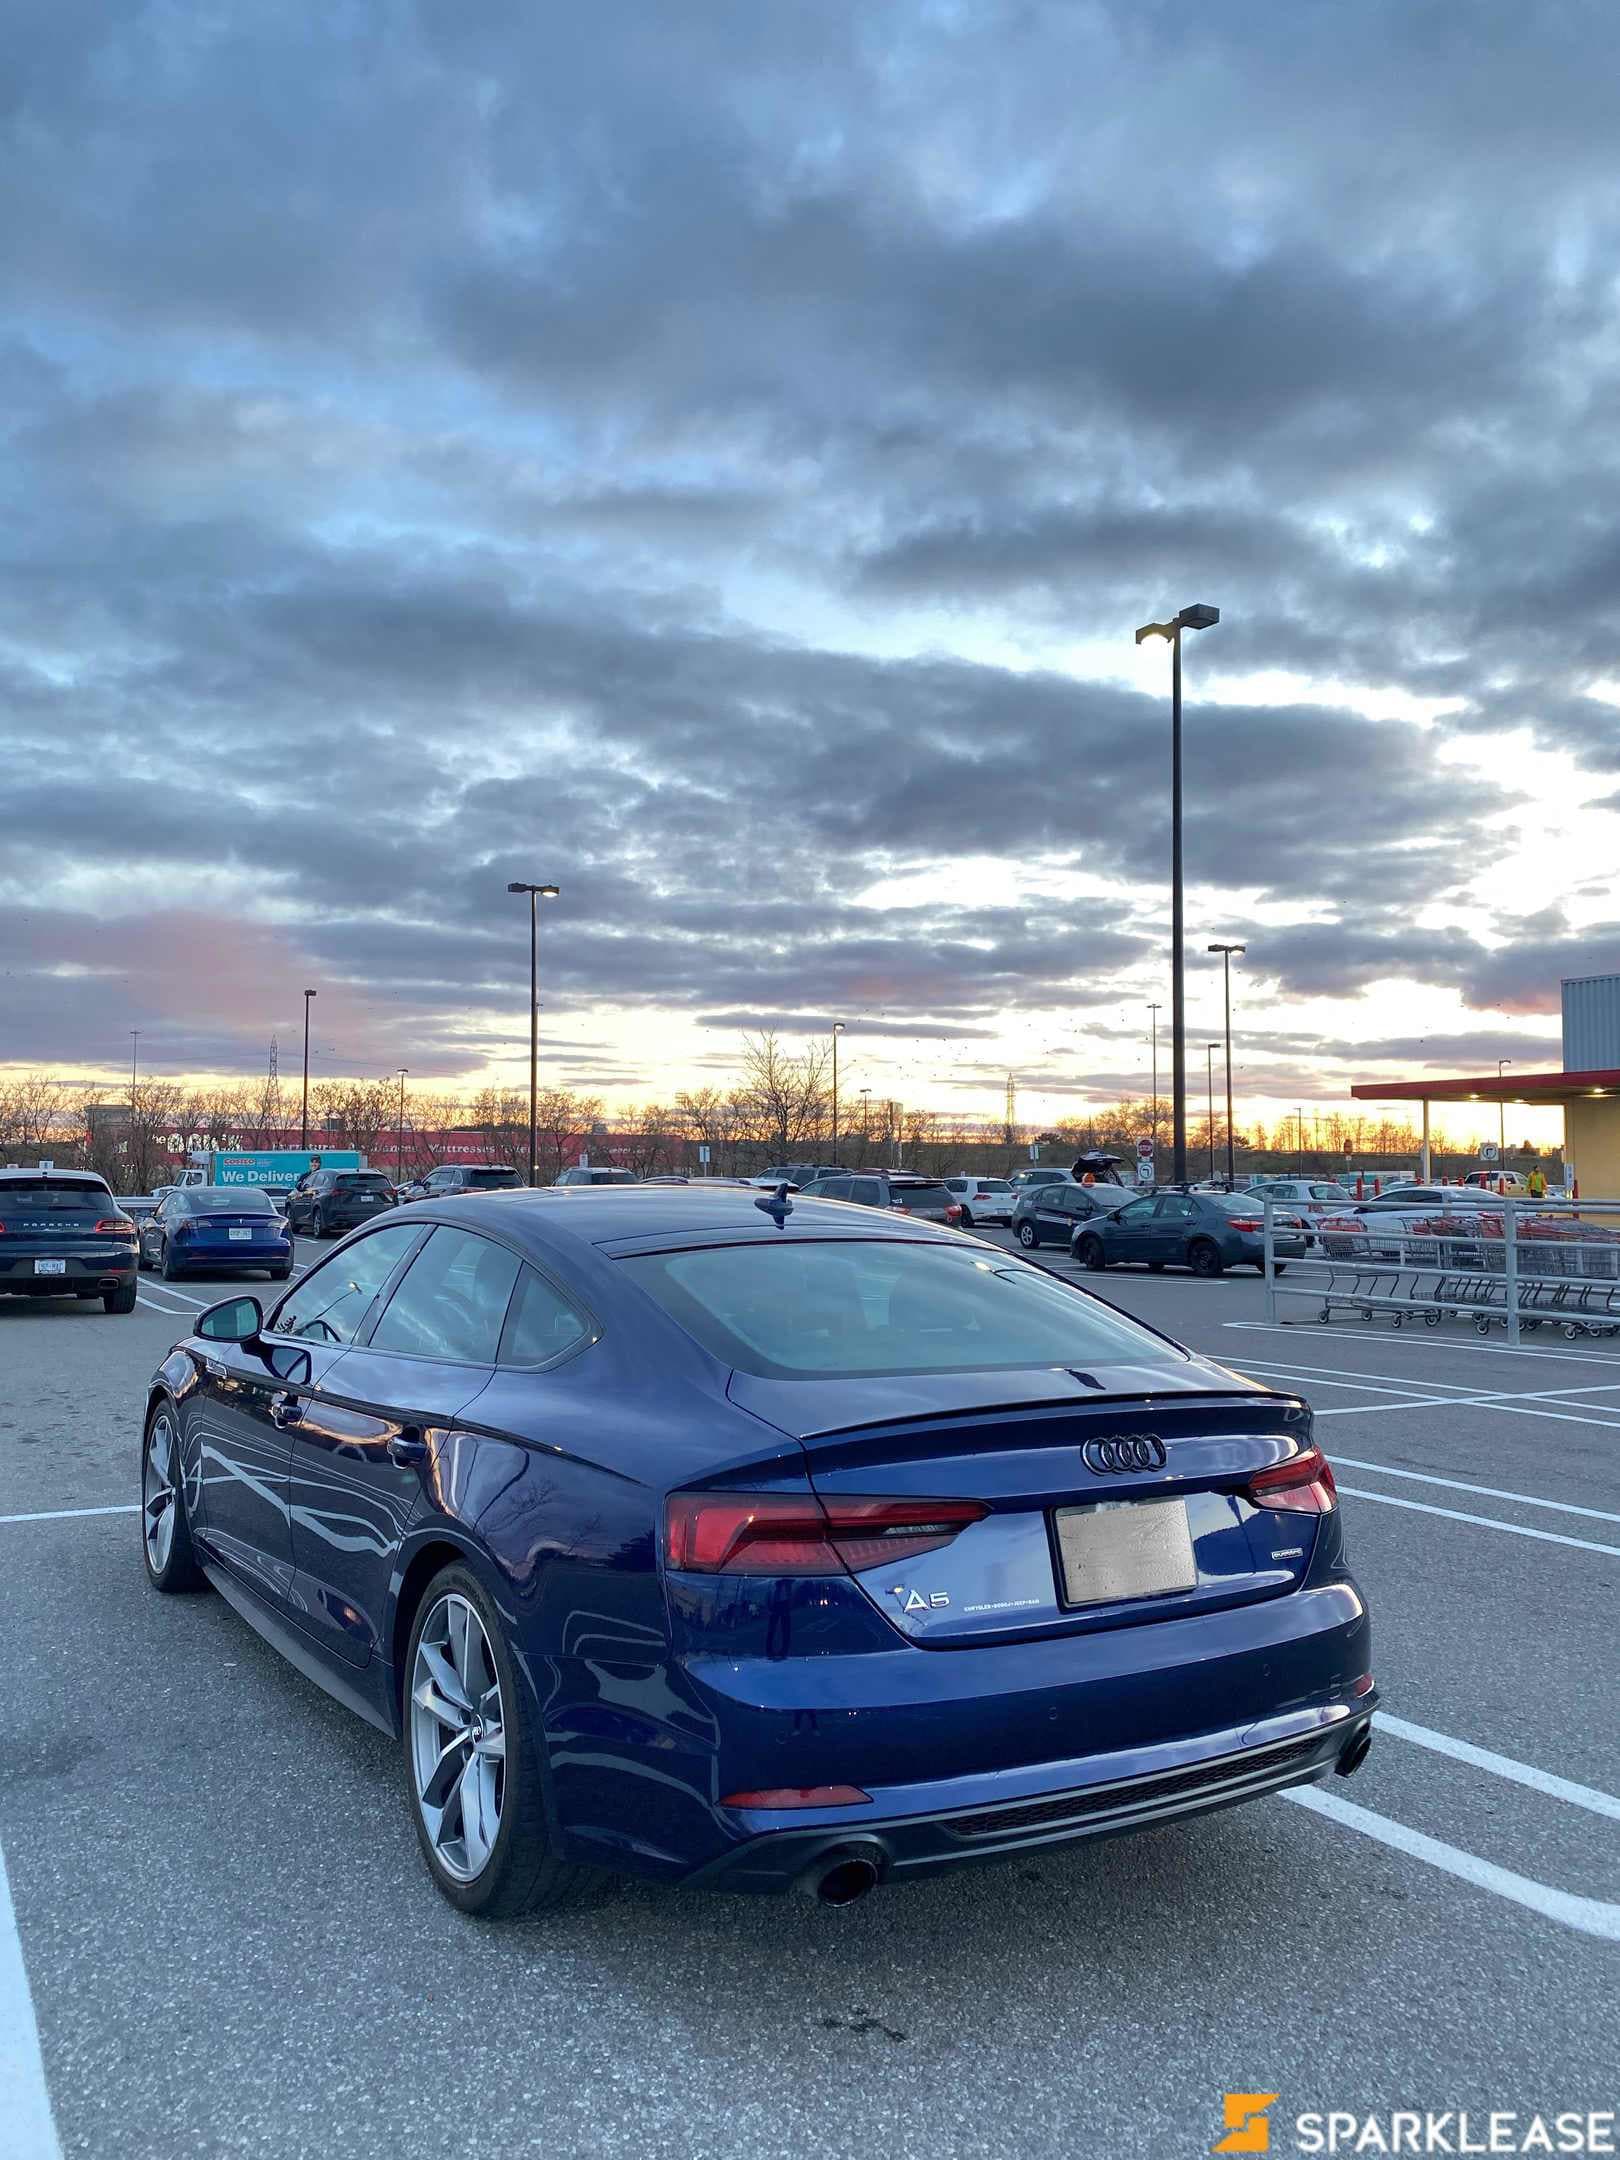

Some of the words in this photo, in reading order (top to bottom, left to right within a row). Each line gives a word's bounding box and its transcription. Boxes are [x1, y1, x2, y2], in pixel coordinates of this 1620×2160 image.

[224, 1158, 256, 1166] COSTCO
[222, 1171, 245, 1183] We
[247, 1170, 300, 1183] Deliver
[903, 1589, 950, 1614] A5
